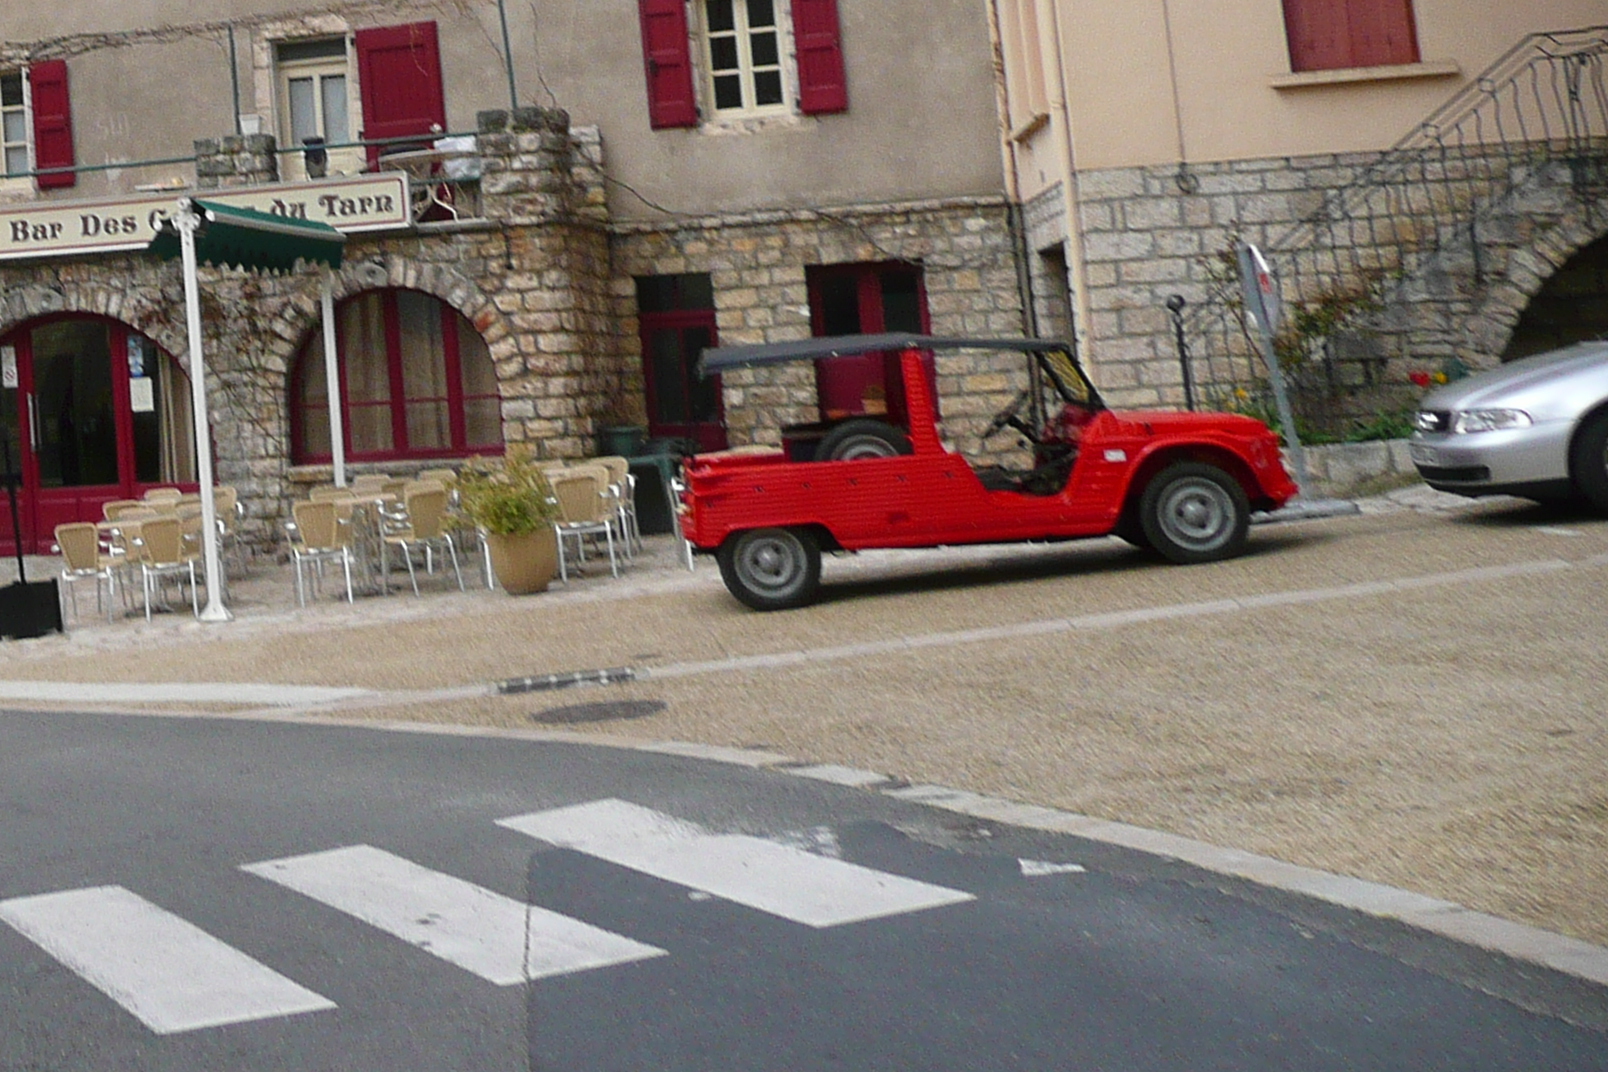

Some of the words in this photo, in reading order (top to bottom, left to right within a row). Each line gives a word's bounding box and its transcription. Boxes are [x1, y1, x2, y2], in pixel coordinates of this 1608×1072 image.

[9, 219, 64, 242] Bar
[79, 213, 138, 237] Des
[318, 193, 395, 218] Tarn
